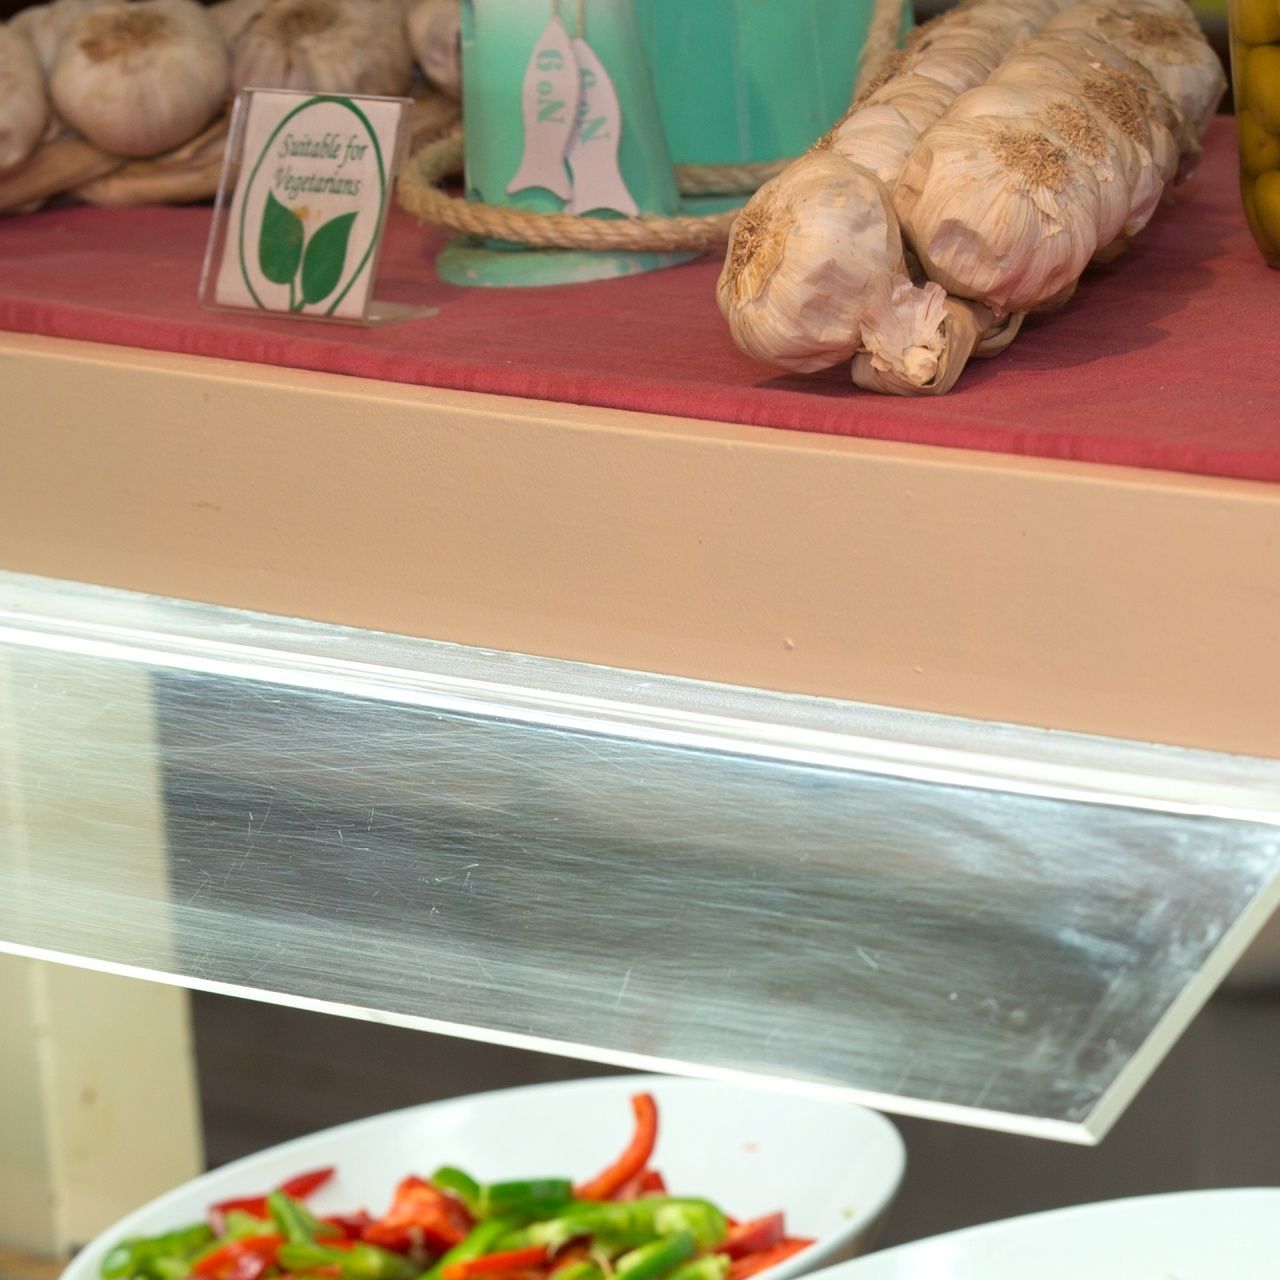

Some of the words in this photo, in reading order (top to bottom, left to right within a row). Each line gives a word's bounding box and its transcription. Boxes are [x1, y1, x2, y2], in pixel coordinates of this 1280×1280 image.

[278, 132, 341, 159] Suitable
[336, 133, 368, 169] for
[273, 165, 362, 200] Vegetarians
